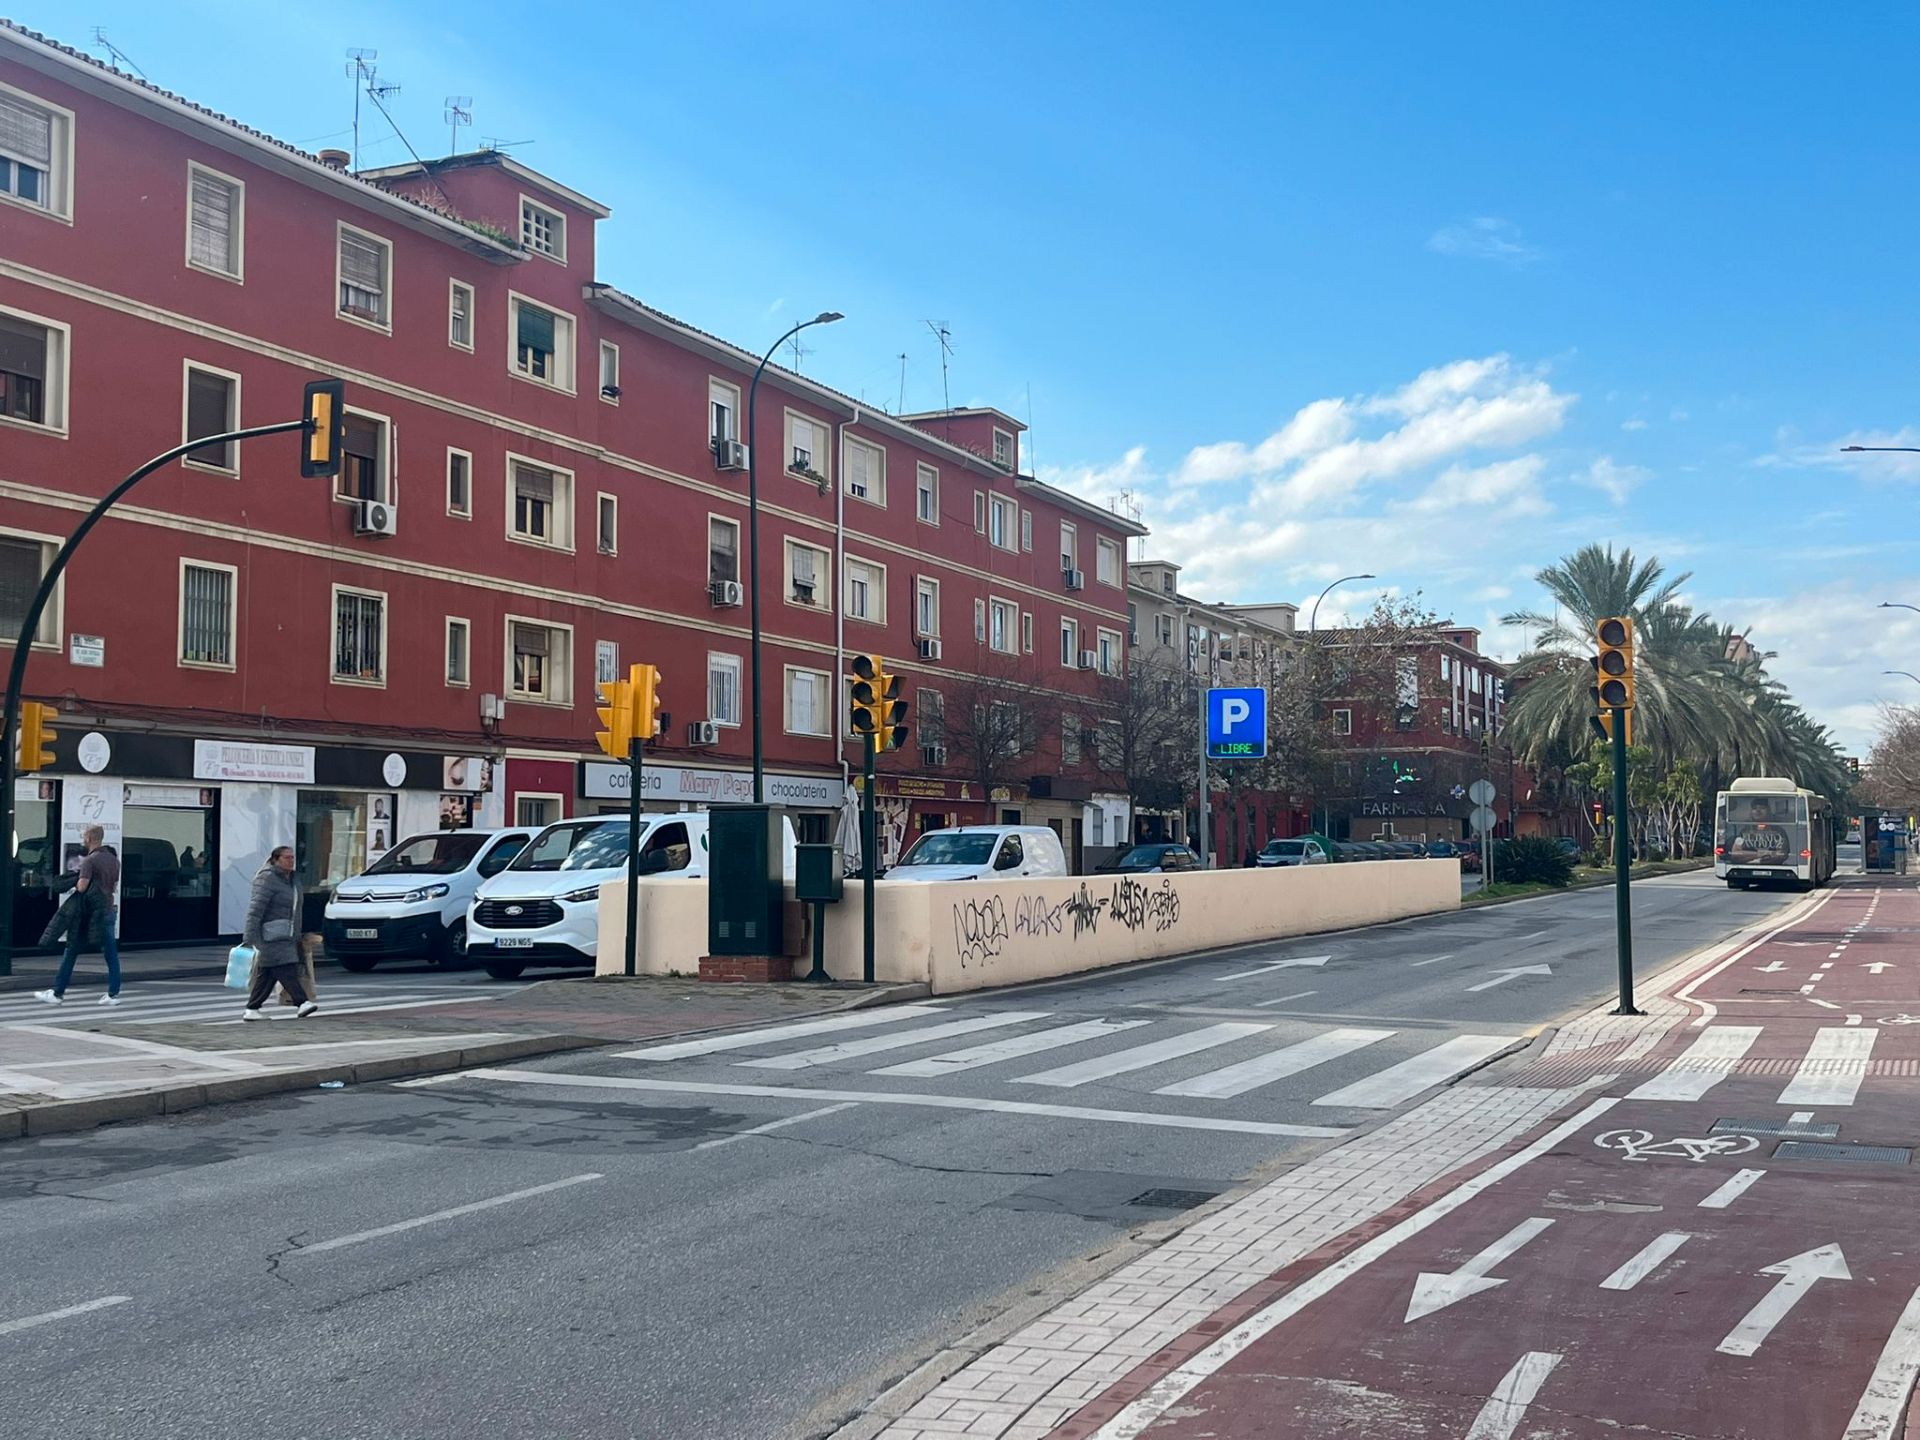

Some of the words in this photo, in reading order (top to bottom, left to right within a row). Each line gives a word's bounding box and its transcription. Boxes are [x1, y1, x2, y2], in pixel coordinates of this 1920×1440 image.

[1222, 698, 1250, 735] P
[1220, 743, 1253, 754] LIBRE
[680, 770, 720, 800] Mary
[1362, 802, 1446, 815] FARMACA
